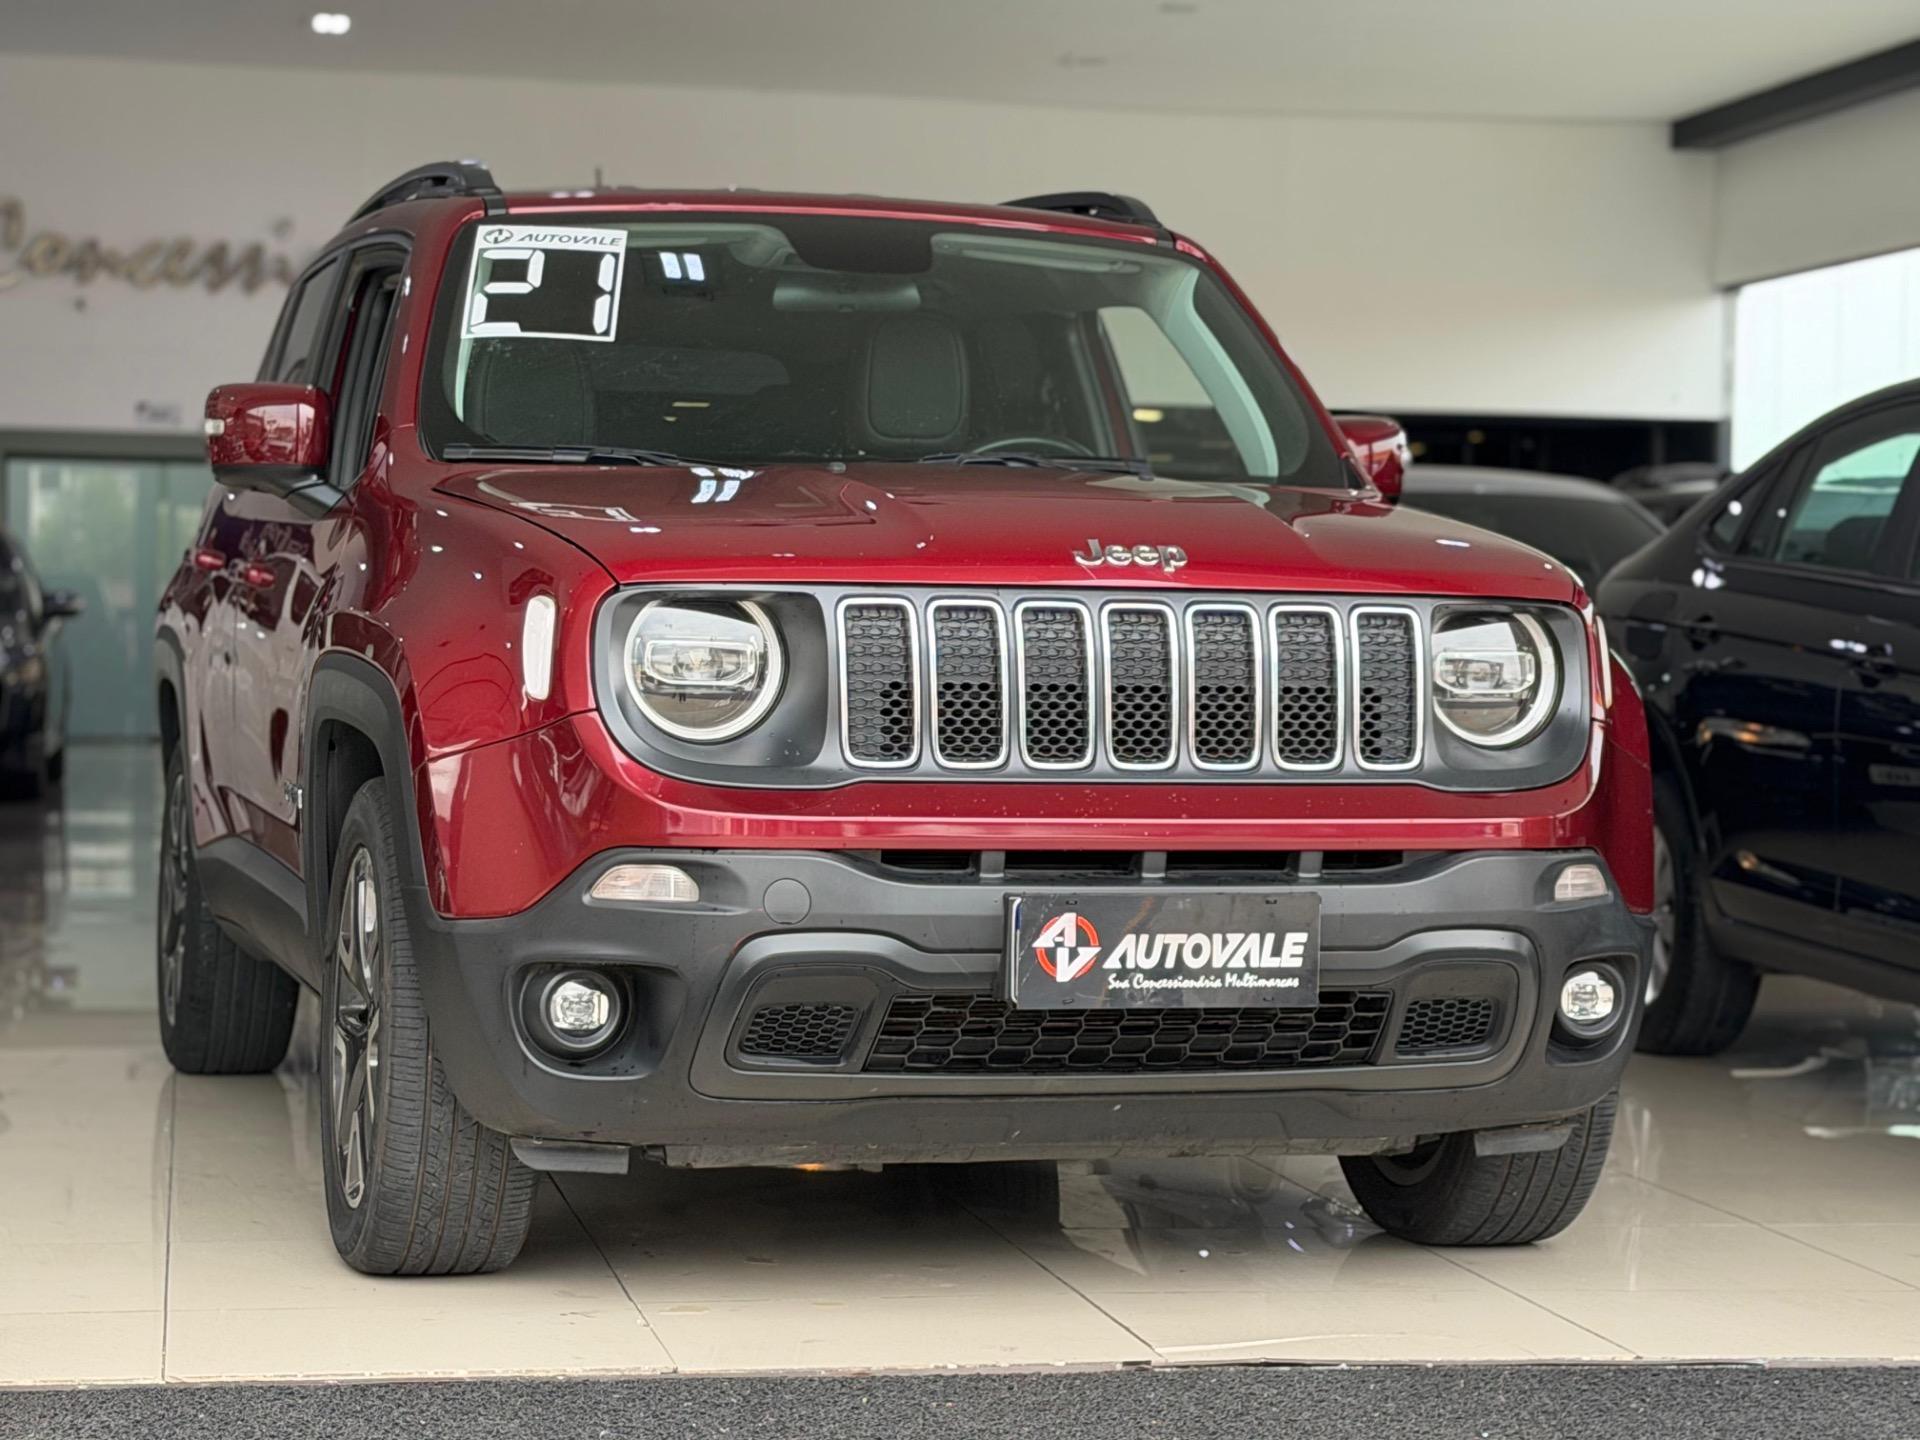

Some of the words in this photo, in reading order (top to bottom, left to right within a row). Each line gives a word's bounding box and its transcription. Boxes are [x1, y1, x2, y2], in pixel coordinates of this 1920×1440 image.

[517, 232, 623, 247] AUTOVALE
[470, 249, 616, 335] 21
[1072, 538, 1188, 573] Jeep
[1102, 932, 1309, 970] AUTOVALE
[1107, 973, 1130, 990] Sua
[1224, 972, 1300, 989] Multimarcas
